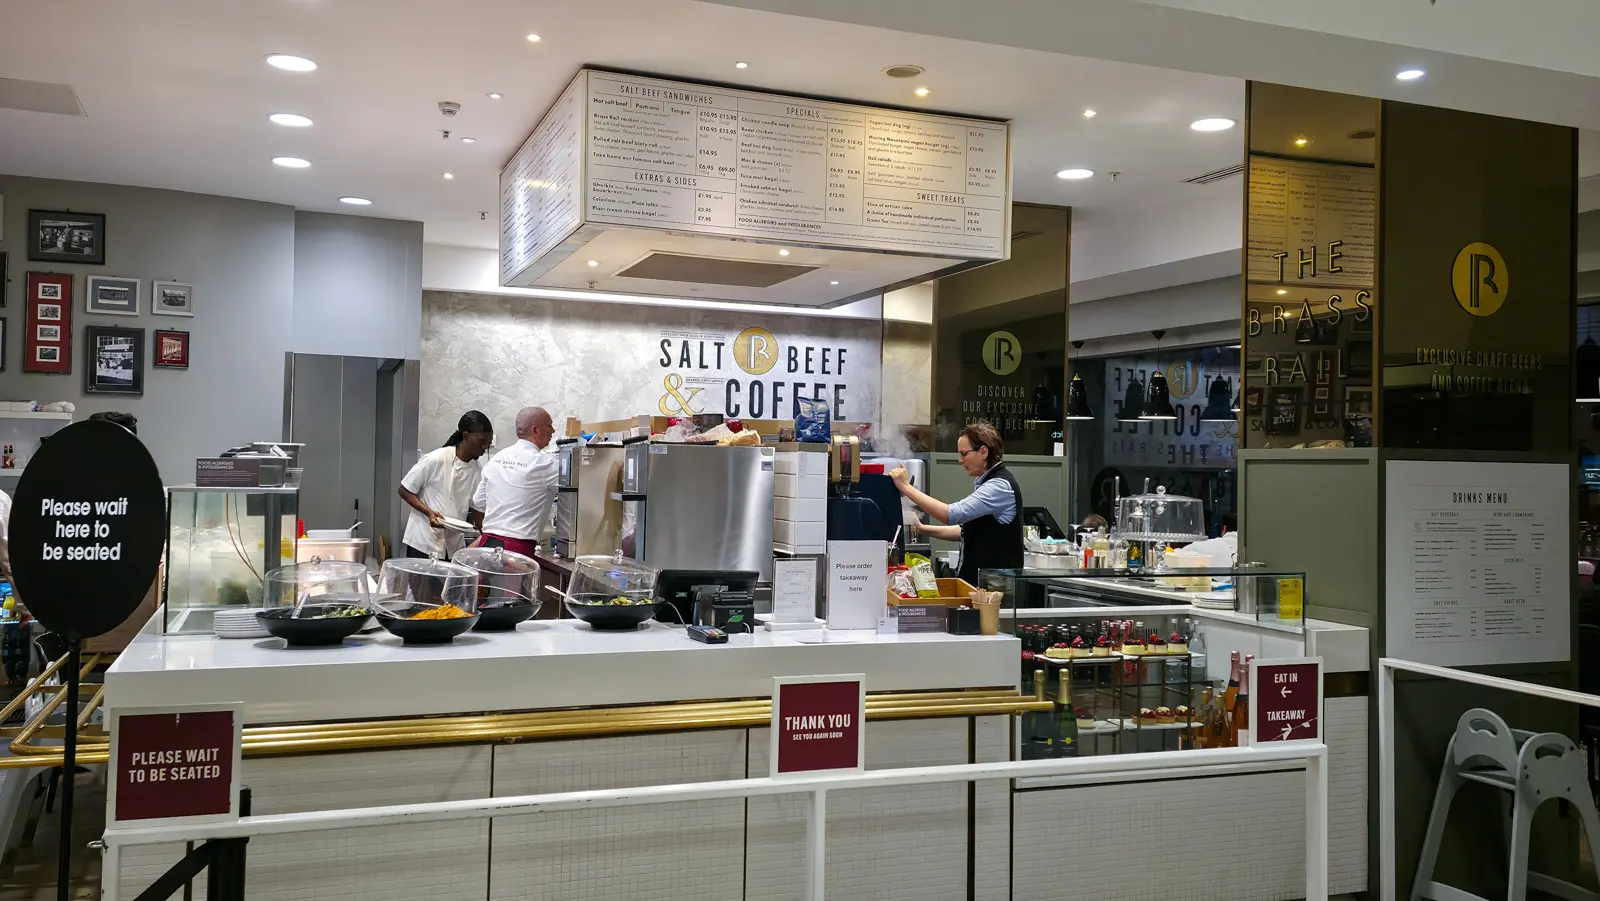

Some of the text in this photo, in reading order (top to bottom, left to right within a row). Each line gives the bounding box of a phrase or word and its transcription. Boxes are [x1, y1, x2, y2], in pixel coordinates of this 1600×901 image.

[620, 85, 713, 105] SALT BEEF SANDWICHES
[671, 107, 690, 116] Tongue
[785, 107, 820, 119] SPECIALS
[634, 172, 663, 182] EXTRAS
[674, 177, 697, 187] SIDES
[916, 193, 965, 204] SWEET TREATS
[753, 218, 777, 226] ALLERGIES
[1272, 239, 1343, 282] THE
[1249, 290, 1370, 337] BRASS
[659, 338, 847, 376] SALT BEEF
[1416, 348, 1471, 366] EXCLUSIVE
[1512, 353, 1542, 370] BEERS
[1265, 349, 1348, 386] RAIL
[1431, 374, 1451, 390] AND
[658, 372, 706, 417] &
[977, 384, 1025, 399] DISCOVER
[963, 400, 1039, 415] OUR EXCLUSIVE
[1005, 418, 1037, 431] BLEND
[1452, 492, 1508, 504] DRINKS MENU
[41, 497, 129, 516] Please wait
[55, 520, 110, 538] here to
[42, 542, 121, 561] be seated
[839, 574, 868, 582] takeaway
[1274, 672, 1298, 684] EAT IN
[785, 713, 851, 731] THANK YOU
[1266, 709, 1306, 722] TAKEAWAY
[793, 731, 843, 741] SEE YOU AGAIN SOON
[132, 748, 220, 766] PLEASE WAIT
[128, 765, 221, 783] TO BE SEATED
